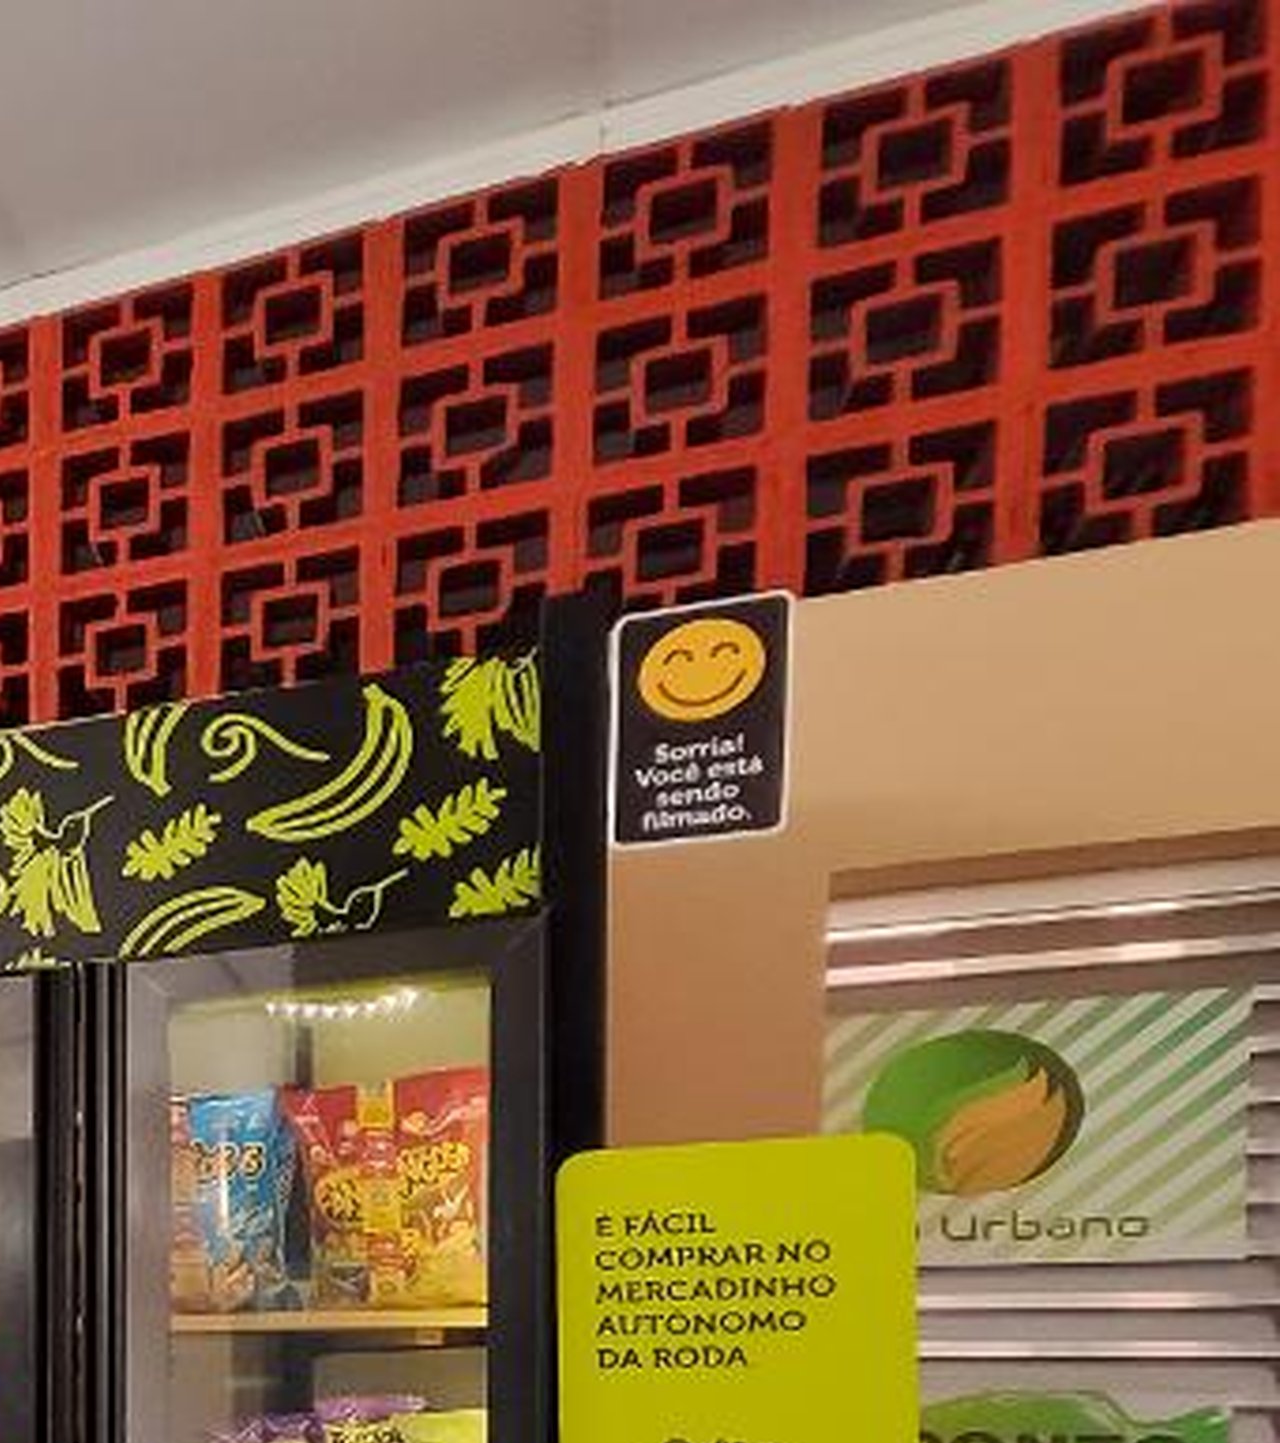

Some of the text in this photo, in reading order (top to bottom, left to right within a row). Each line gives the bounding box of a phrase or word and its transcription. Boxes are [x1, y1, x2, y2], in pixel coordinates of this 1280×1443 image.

[654, 733, 744, 764] Sorria!
[634, 755, 764, 787] Você está
[656, 781, 740, 808] sendo
[643, 804, 753, 832] filmado.
[624, 1209, 717, 1237] FÁCIL
[595, 1239, 832, 1271] COMPRAR NO
[595, 1273, 837, 1303] MERCADINHO
[597, 1345, 749, 1370] DA RODA
